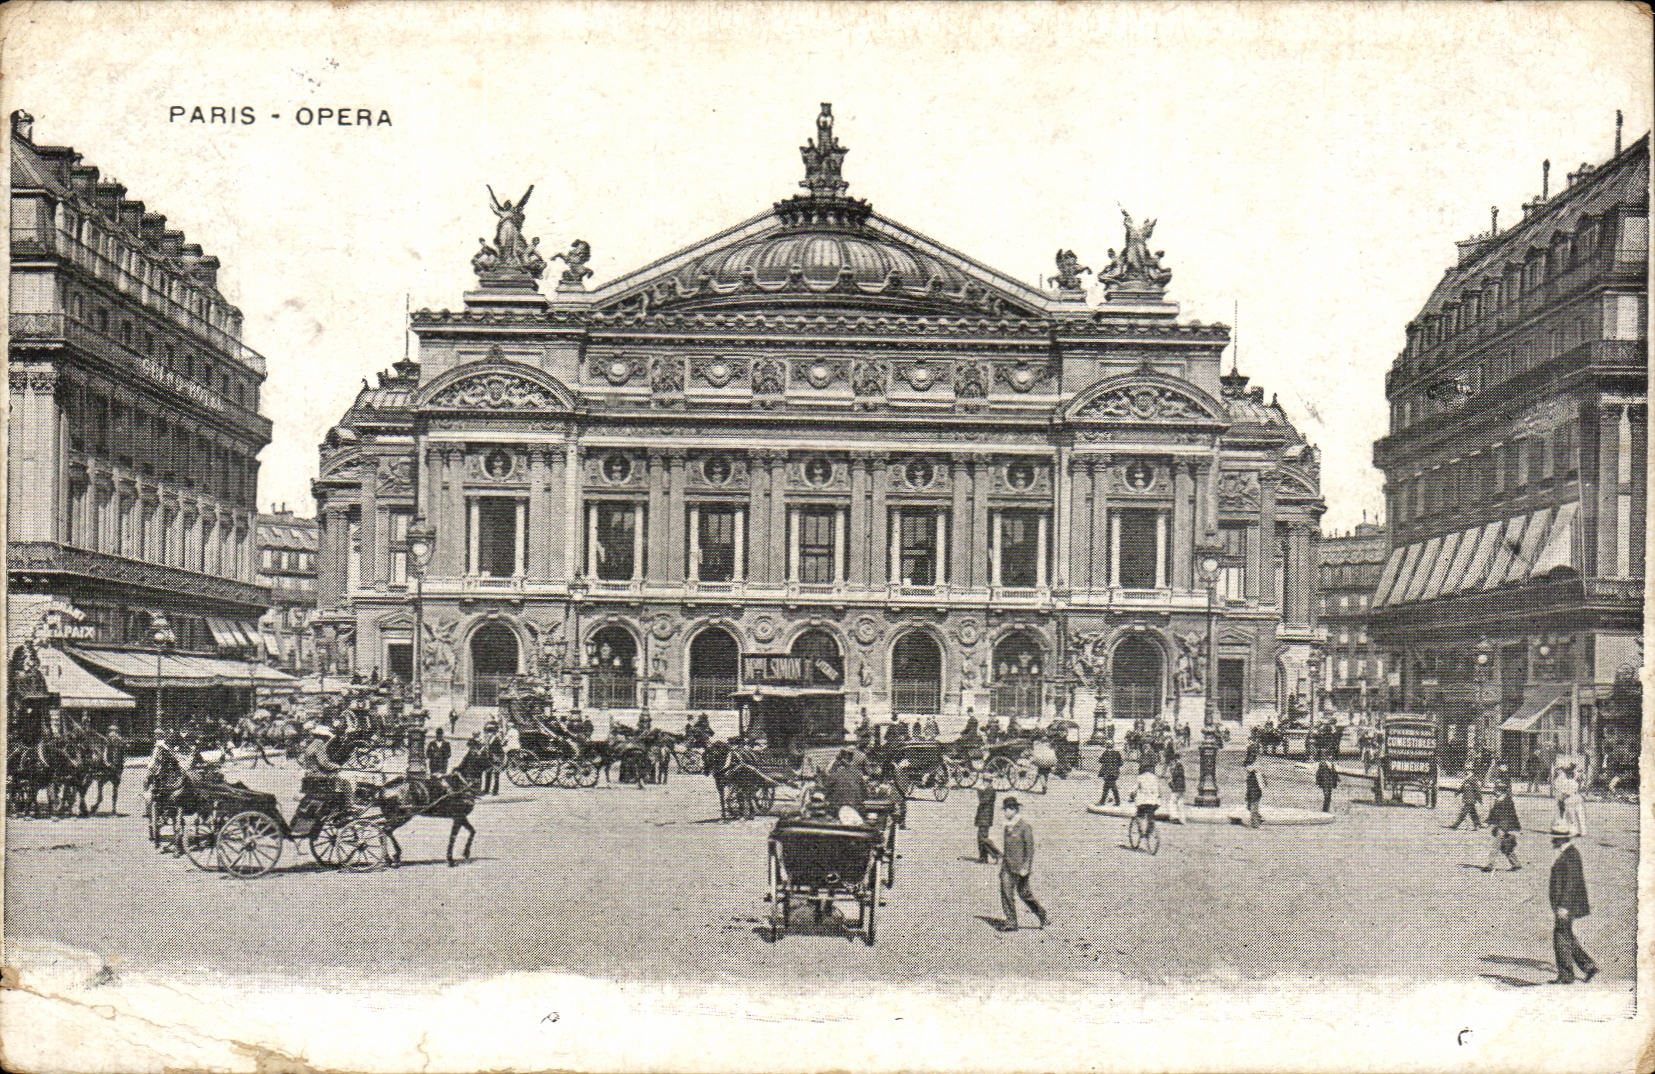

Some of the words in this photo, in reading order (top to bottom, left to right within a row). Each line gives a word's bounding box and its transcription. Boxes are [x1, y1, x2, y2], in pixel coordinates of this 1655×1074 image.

[64, 625, 94, 638] PAIX
[1387, 736, 1436, 749] COMESTIBLES
[1391, 760, 1430, 773] PRIMEURS
